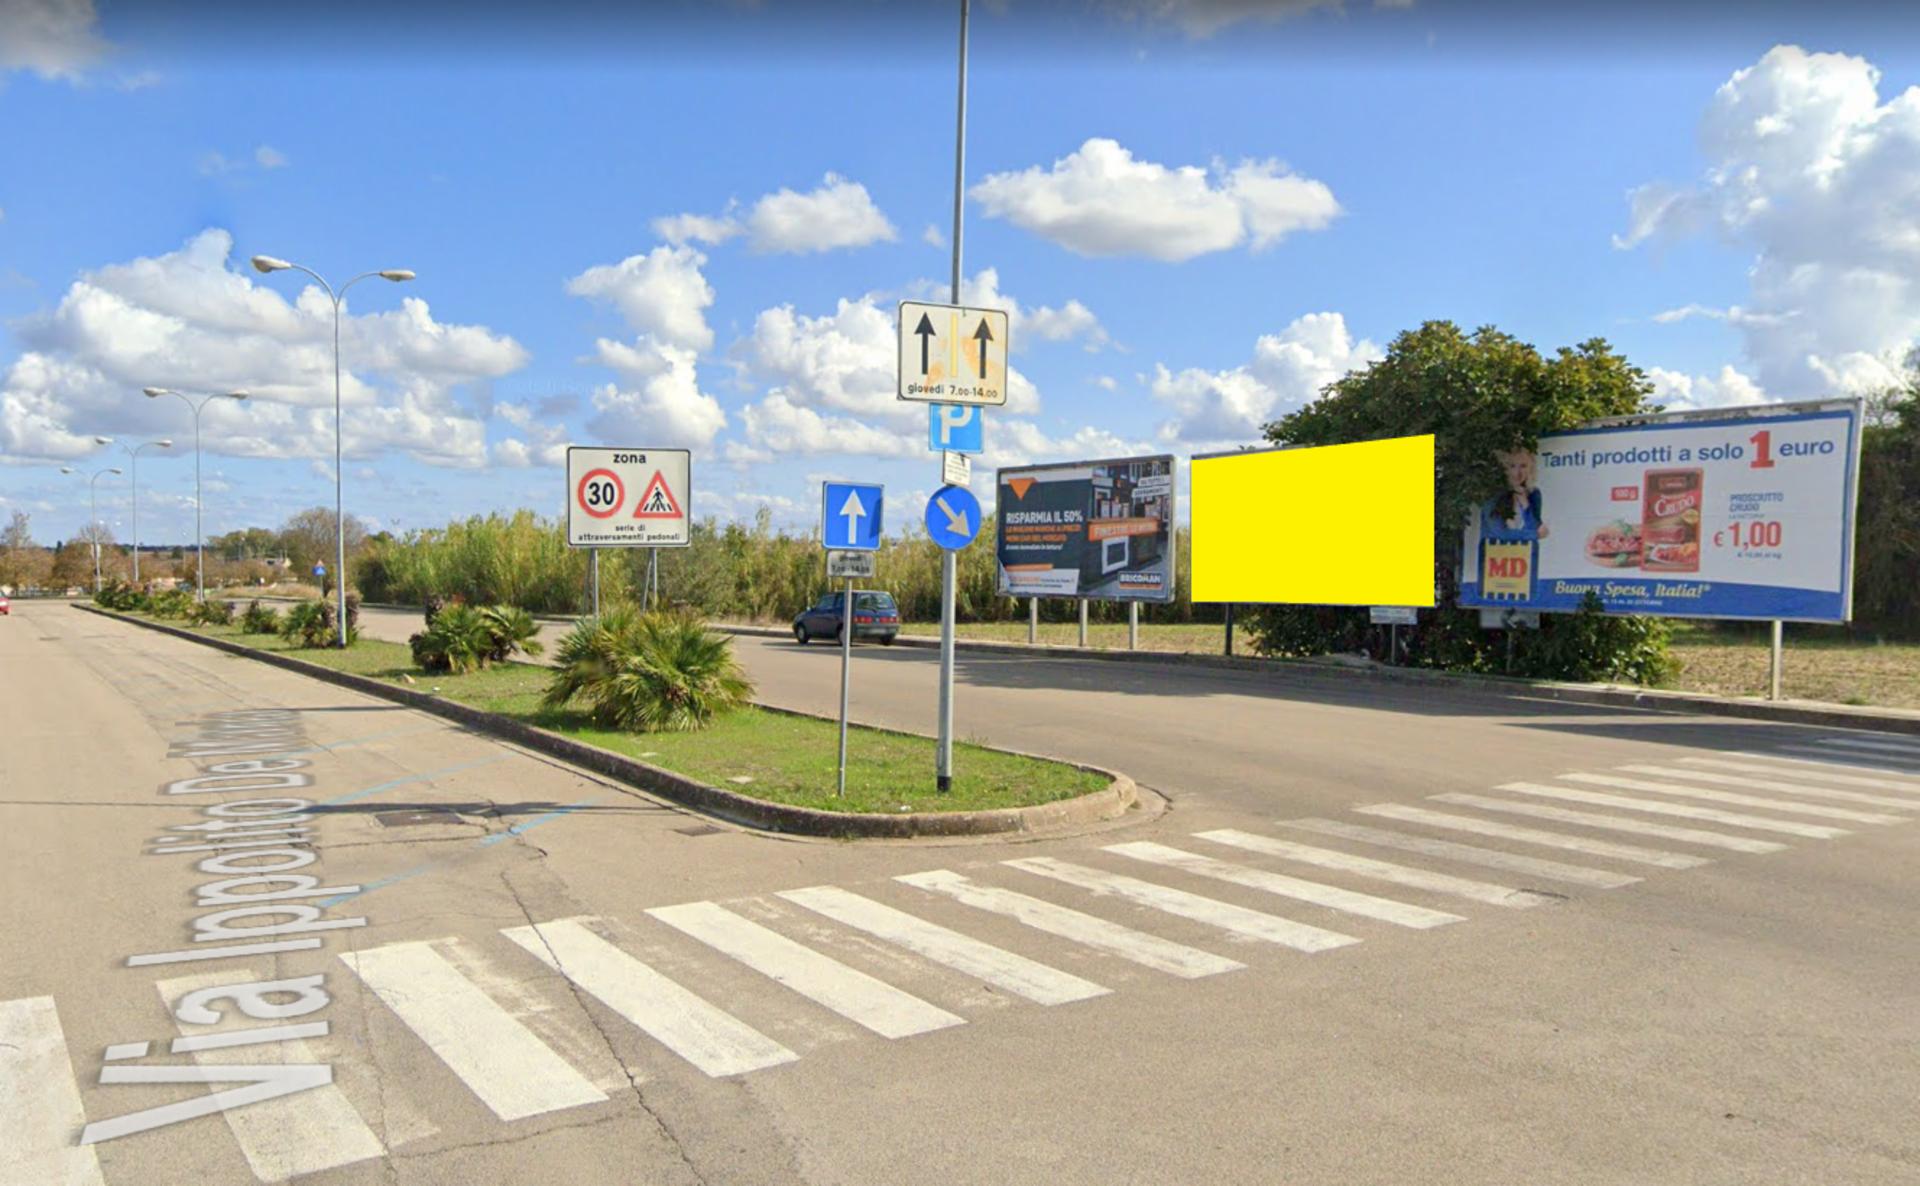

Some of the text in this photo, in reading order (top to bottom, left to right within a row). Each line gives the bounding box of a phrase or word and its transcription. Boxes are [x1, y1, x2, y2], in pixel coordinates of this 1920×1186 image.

[939, 405, 973, 445] P
[613, 453, 647, 464] zona
[1541, 430, 1834, 469] Tanti prodotti a solo 1 euro
[588, 481, 615, 506] 30
[615, 523, 646, 532] serie di
[1006, 510, 1084, 524] RISPARMIA IL 50%
[1713, 521, 1782, 550] € 1,00
[1488, 557, 1527, 577] MD
